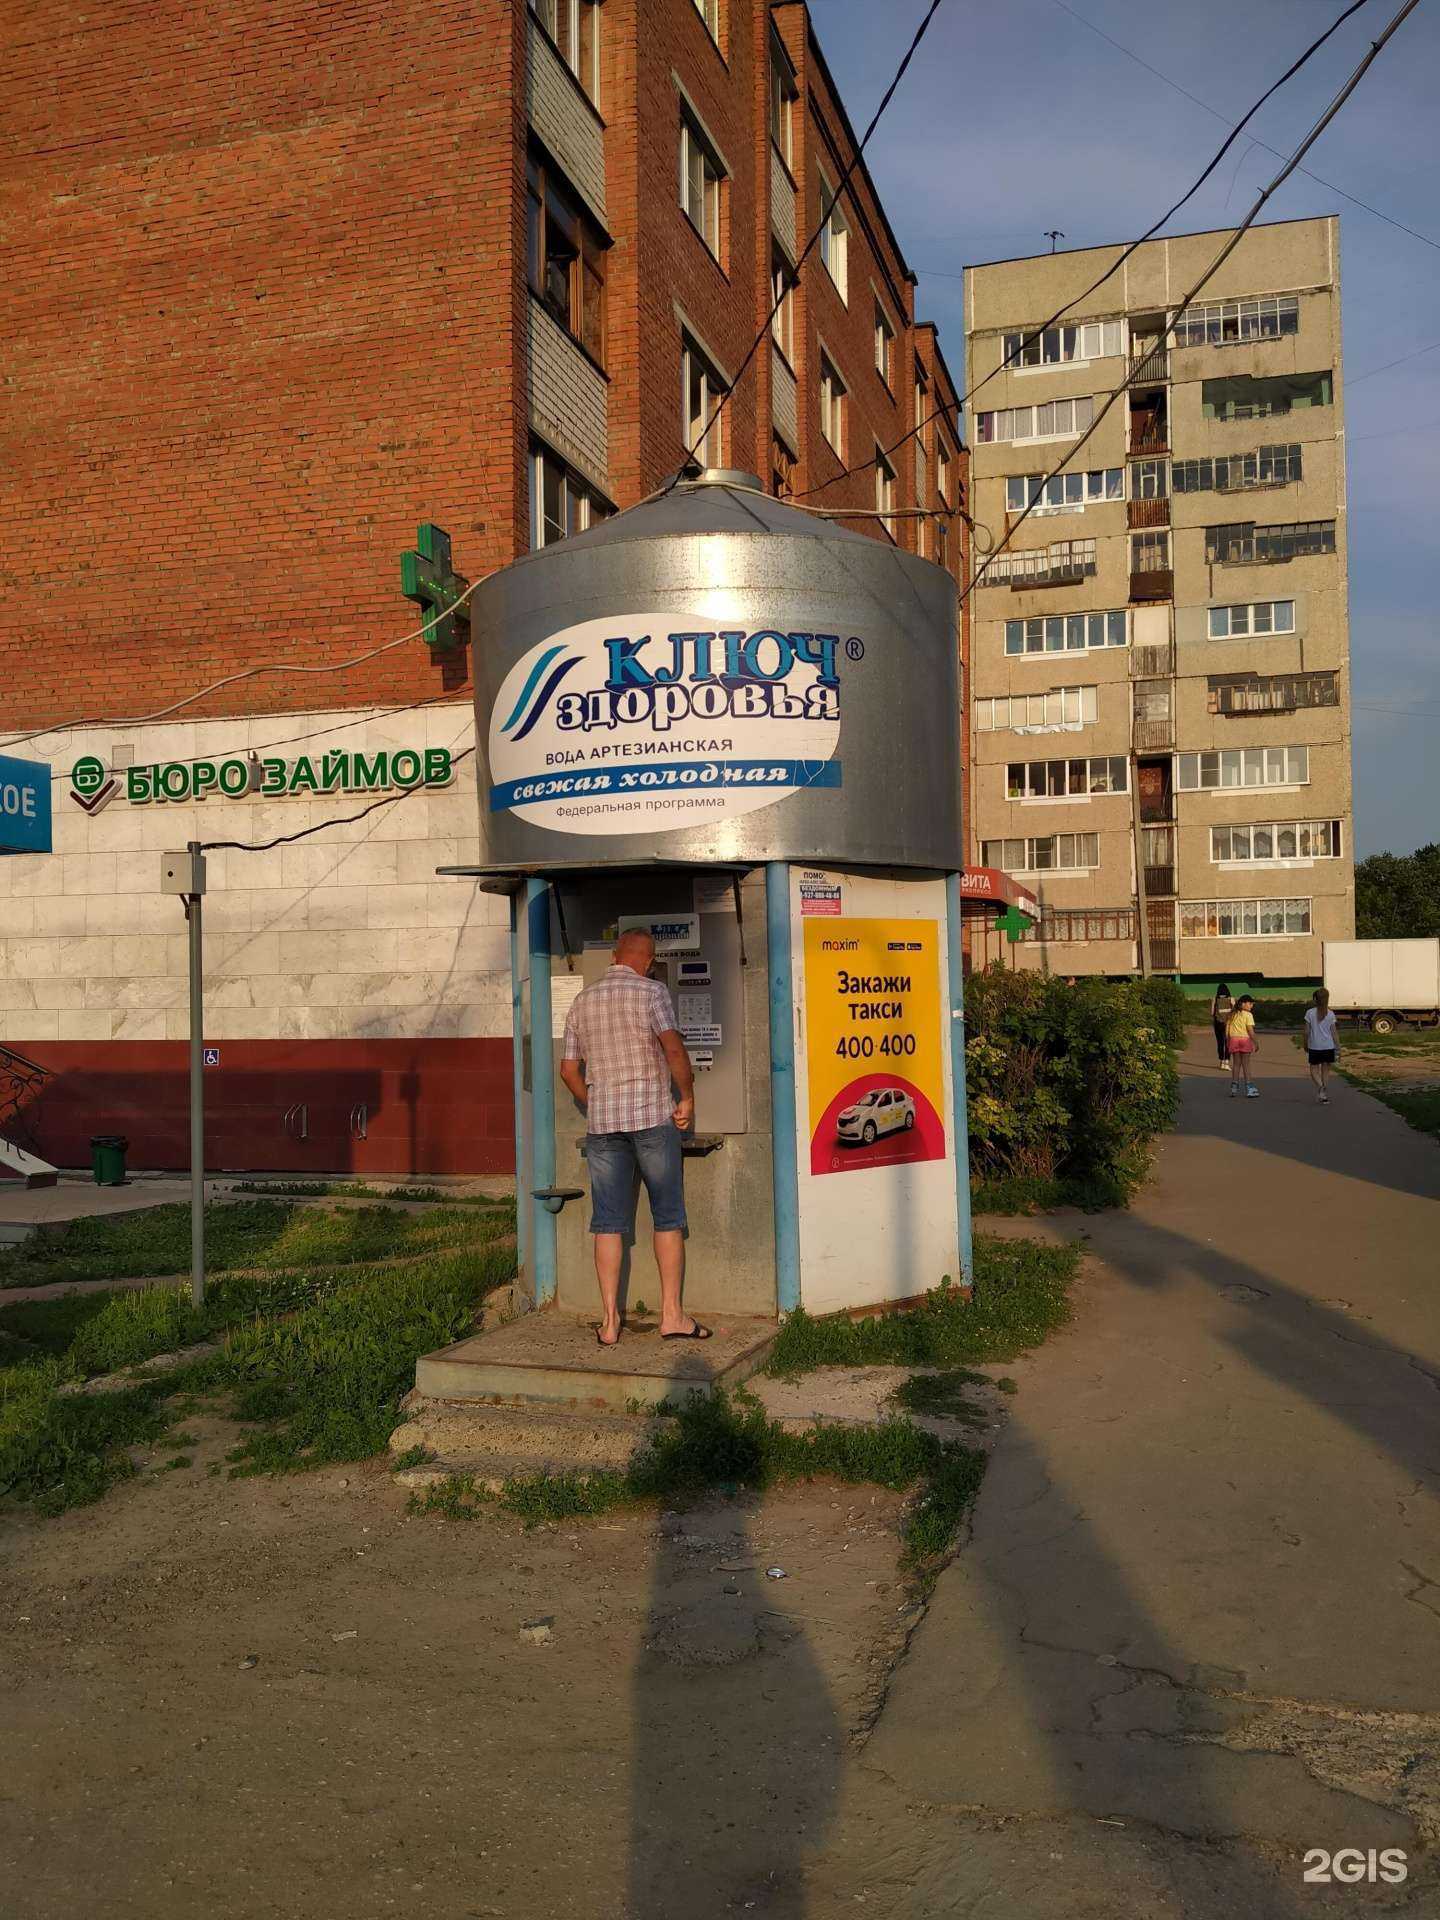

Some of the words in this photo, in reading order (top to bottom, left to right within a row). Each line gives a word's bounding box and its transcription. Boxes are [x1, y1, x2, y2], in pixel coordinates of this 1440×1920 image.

[603, 630, 840, 690] КЛЮЧ
[556, 681, 841, 732] здоровья
[545, 748, 585, 766] ВОДА
[590, 738, 733, 760] АРТЕЗИАНСКАЯ
[127, 763, 249, 801] БЮРО
[261, 748, 453, 793] ЗАЙМОВ
[512, 773, 613, 801] свежая
[617, 763, 790, 789] холодная
[0, 782, 36, 817] ОЕ
[556, 799, 642, 818] Федеральная
[645, 796, 726, 811] программа
[961, 873, 991, 889] ВИТА
[822, 939, 859, 951] maxim
[837, 971, 912, 994] Закажи
[848, 1001, 903, 1020] такси
[835, 1037, 874, 1058] 400
[879, 1034, 916, 1056] 400
